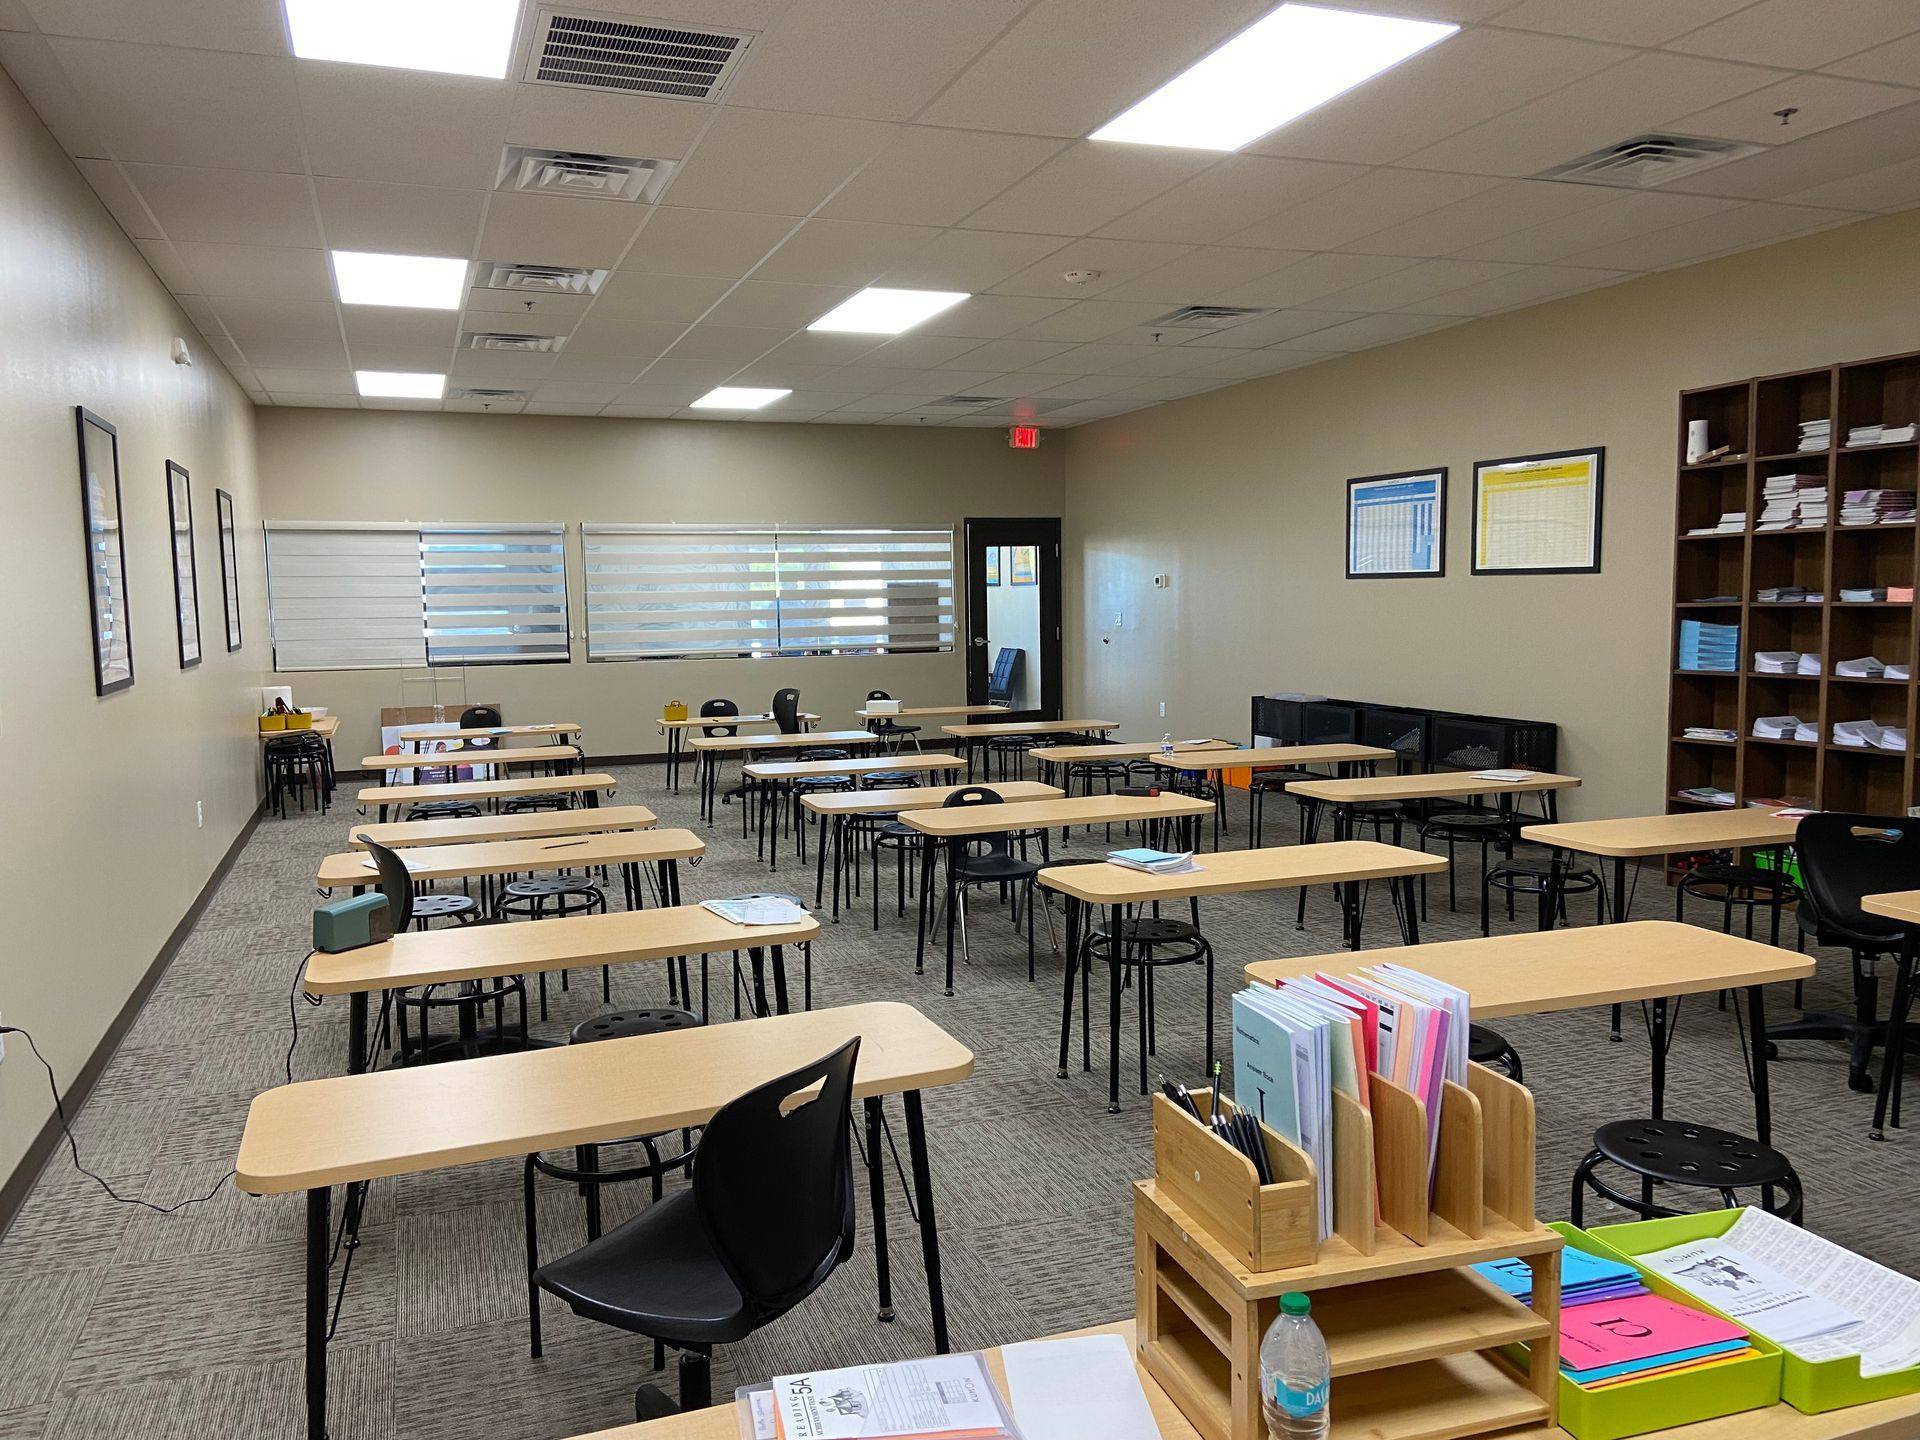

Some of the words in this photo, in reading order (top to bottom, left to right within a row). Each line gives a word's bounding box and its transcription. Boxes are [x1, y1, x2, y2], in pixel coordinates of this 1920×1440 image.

[1015, 427, 1038, 448] EXIT
[1664, 1250, 1705, 1264] KUMON
[790, 1377, 813, 1395] 5A
[963, 1377, 980, 1402] KUMON
[790, 1396, 808, 1437] READING
